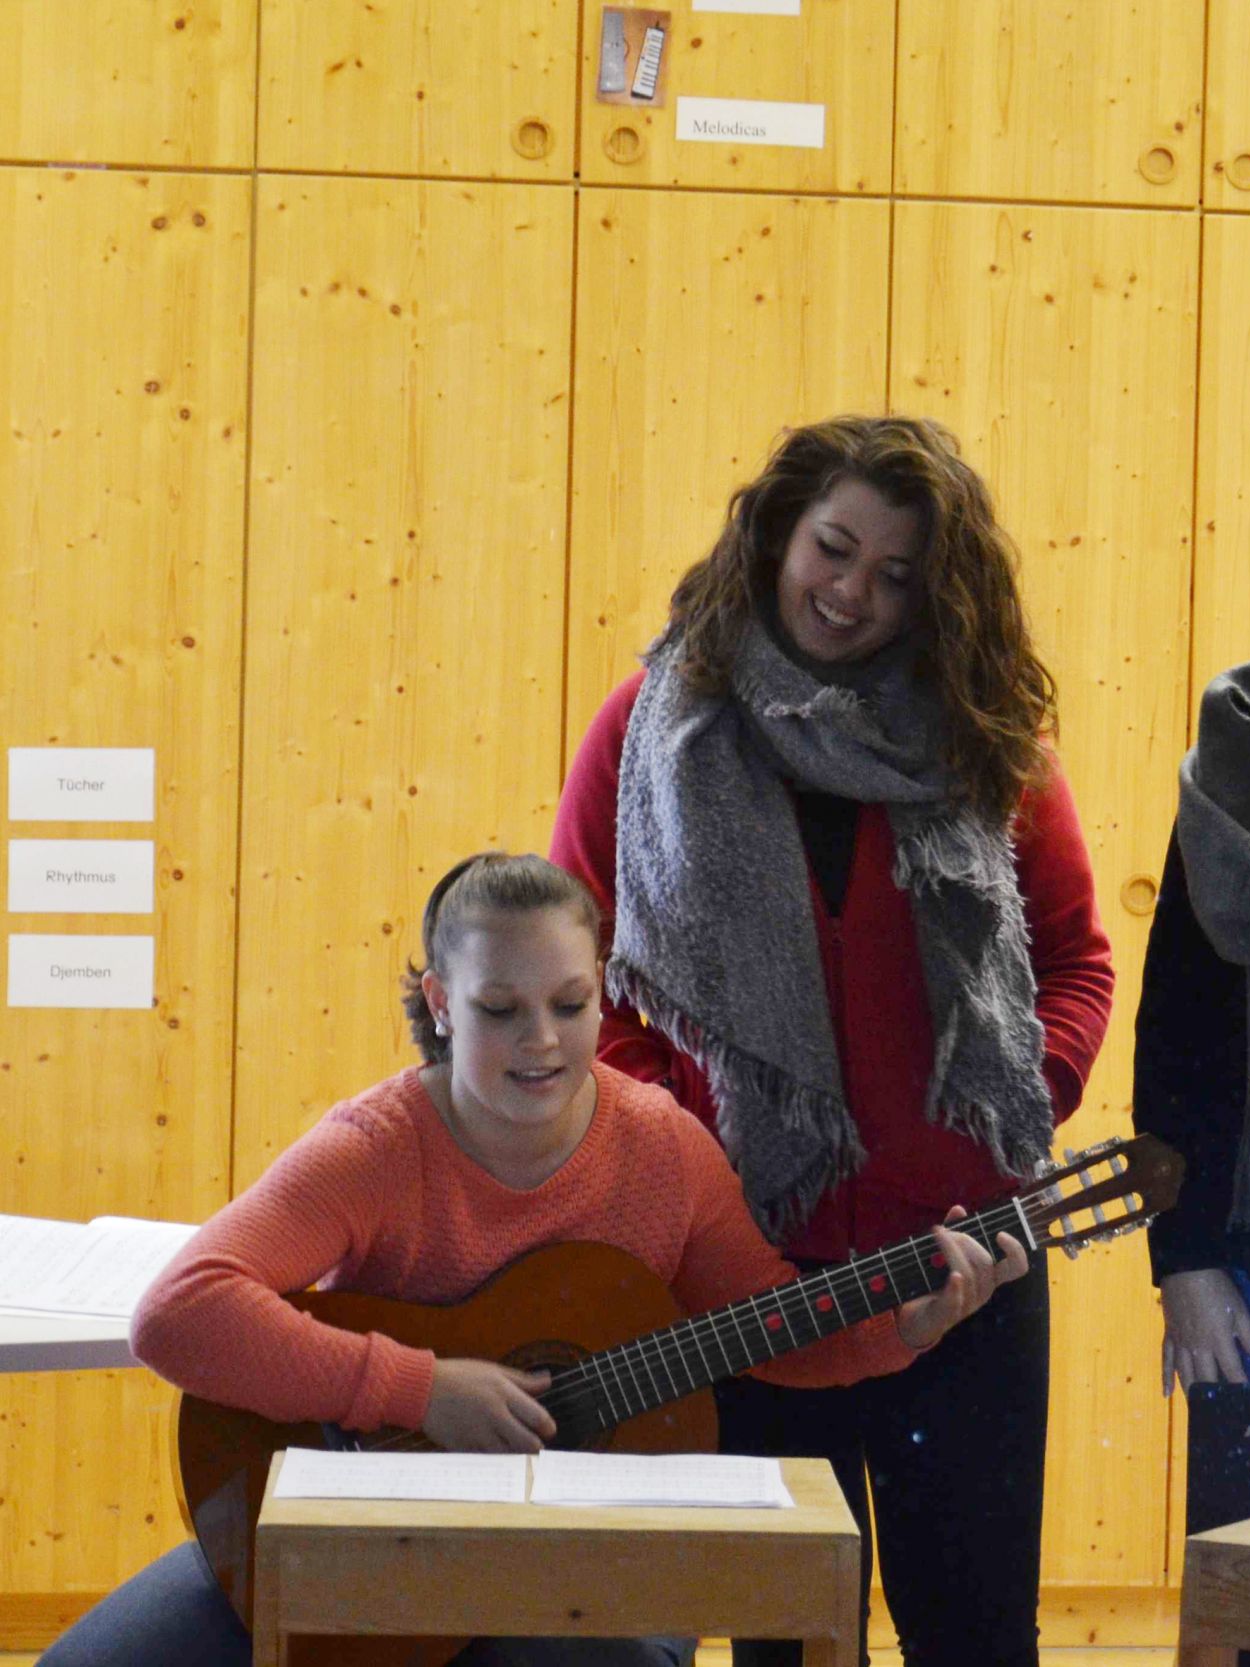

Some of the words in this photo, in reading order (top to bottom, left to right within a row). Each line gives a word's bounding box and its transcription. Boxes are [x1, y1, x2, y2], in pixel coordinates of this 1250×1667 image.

[692, 119, 767, 138] Melodicas
[57, 778, 105, 792] Tücher
[46, 869, 116, 885] Rhythmus
[50, 965, 111, 980] Djemben
